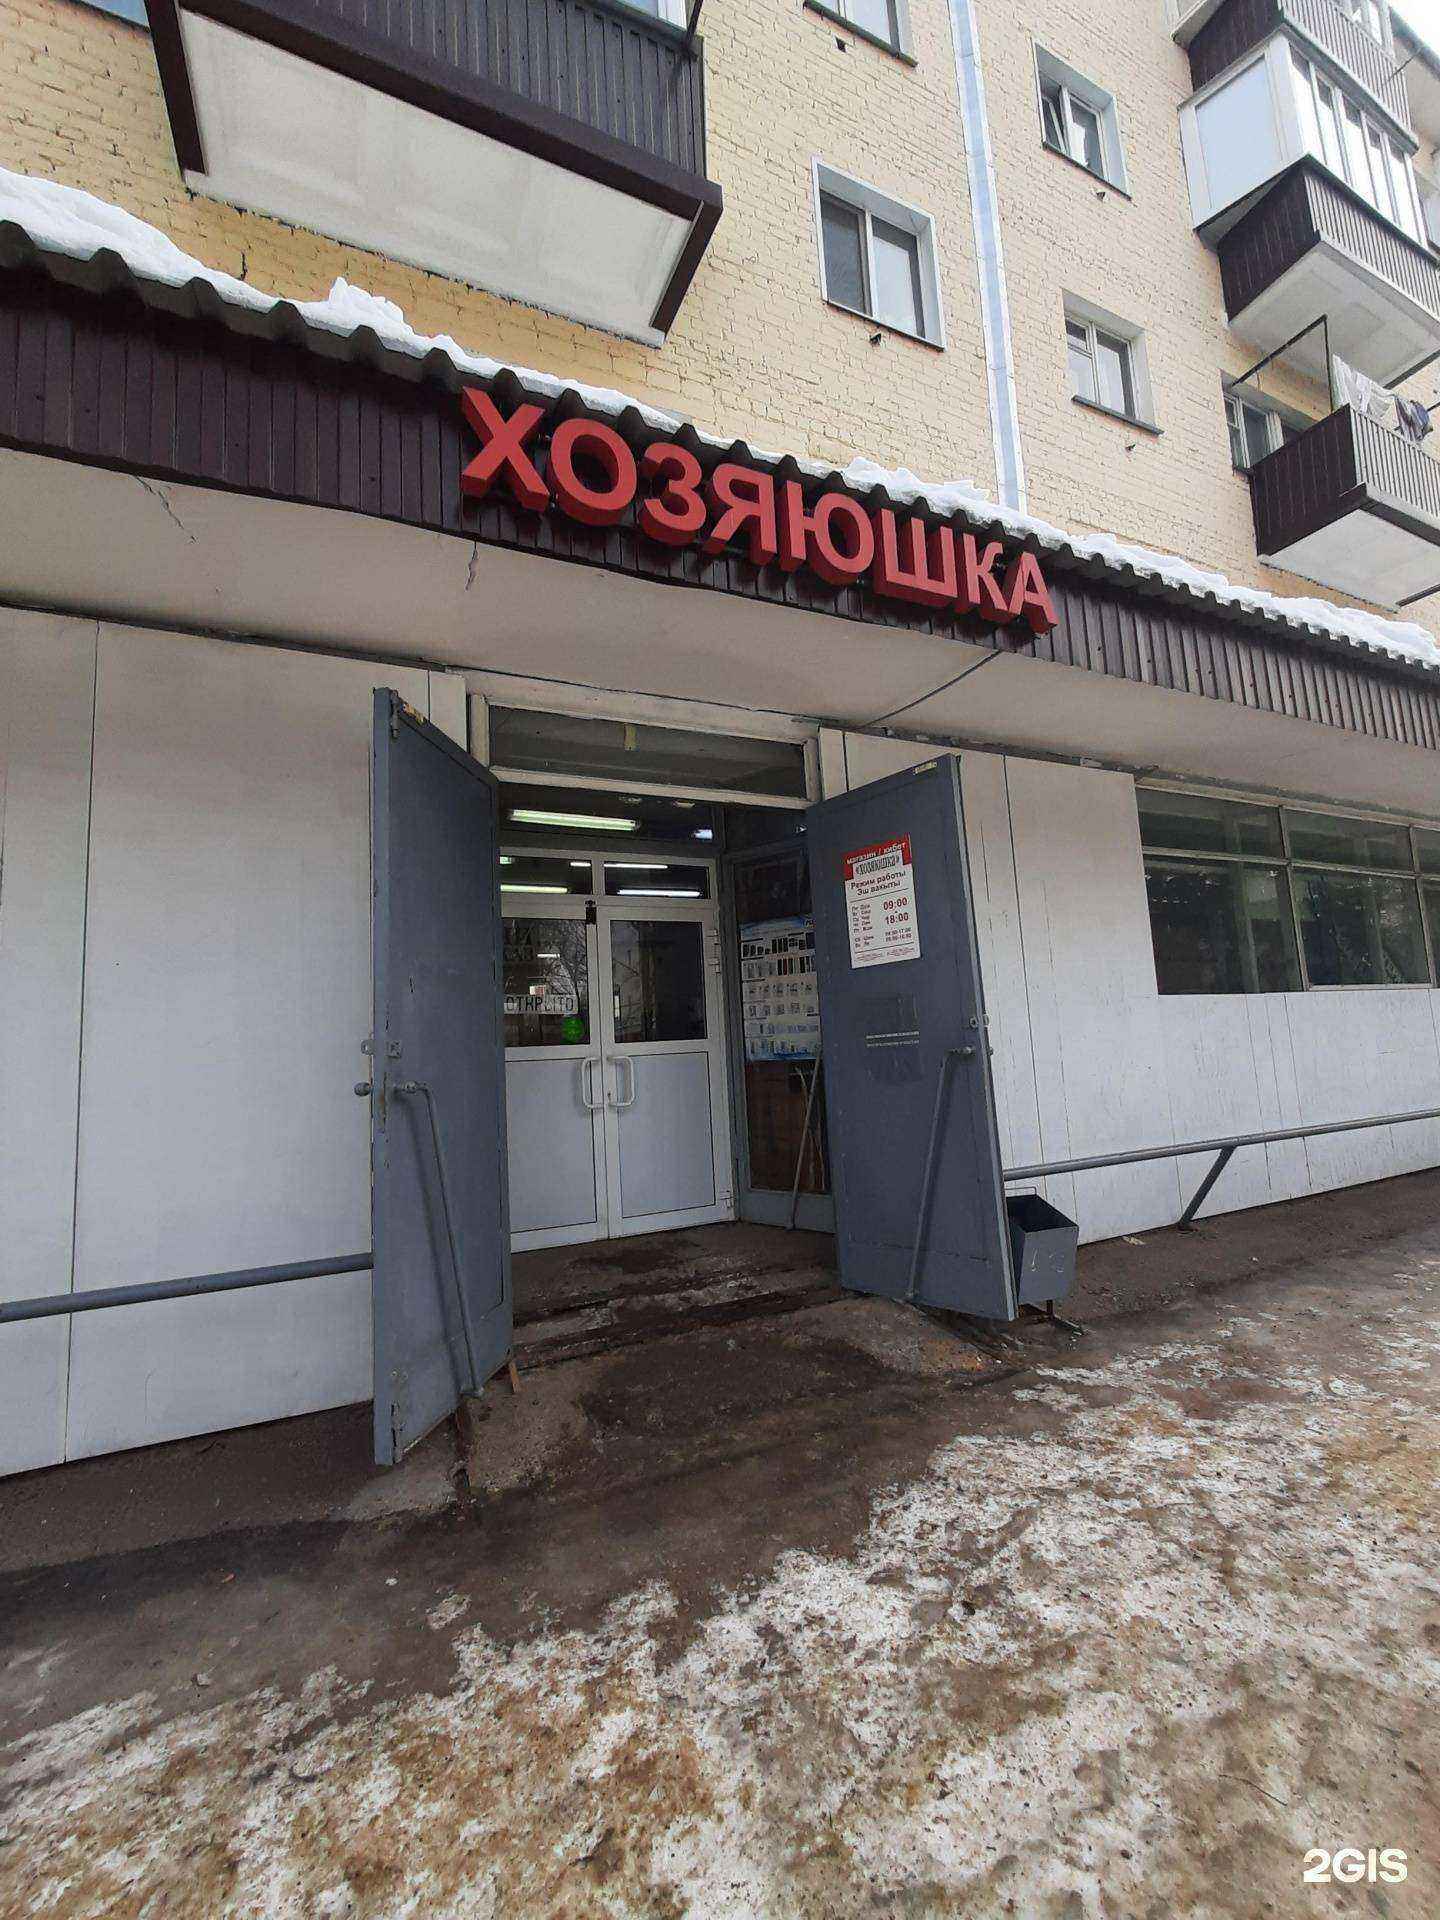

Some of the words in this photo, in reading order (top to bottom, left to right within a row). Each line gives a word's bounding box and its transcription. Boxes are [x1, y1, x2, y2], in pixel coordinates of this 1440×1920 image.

[461, 386, 1059, 632] ХОЗЯЮШКА
[851, 879, 875, 889] Режим
[877, 871, 906, 883] работы
[883, 897, 908, 910] 09:00
[885, 912, 909, 924] 18:00
[506, 996, 574, 1012] ОТКРЫТО
